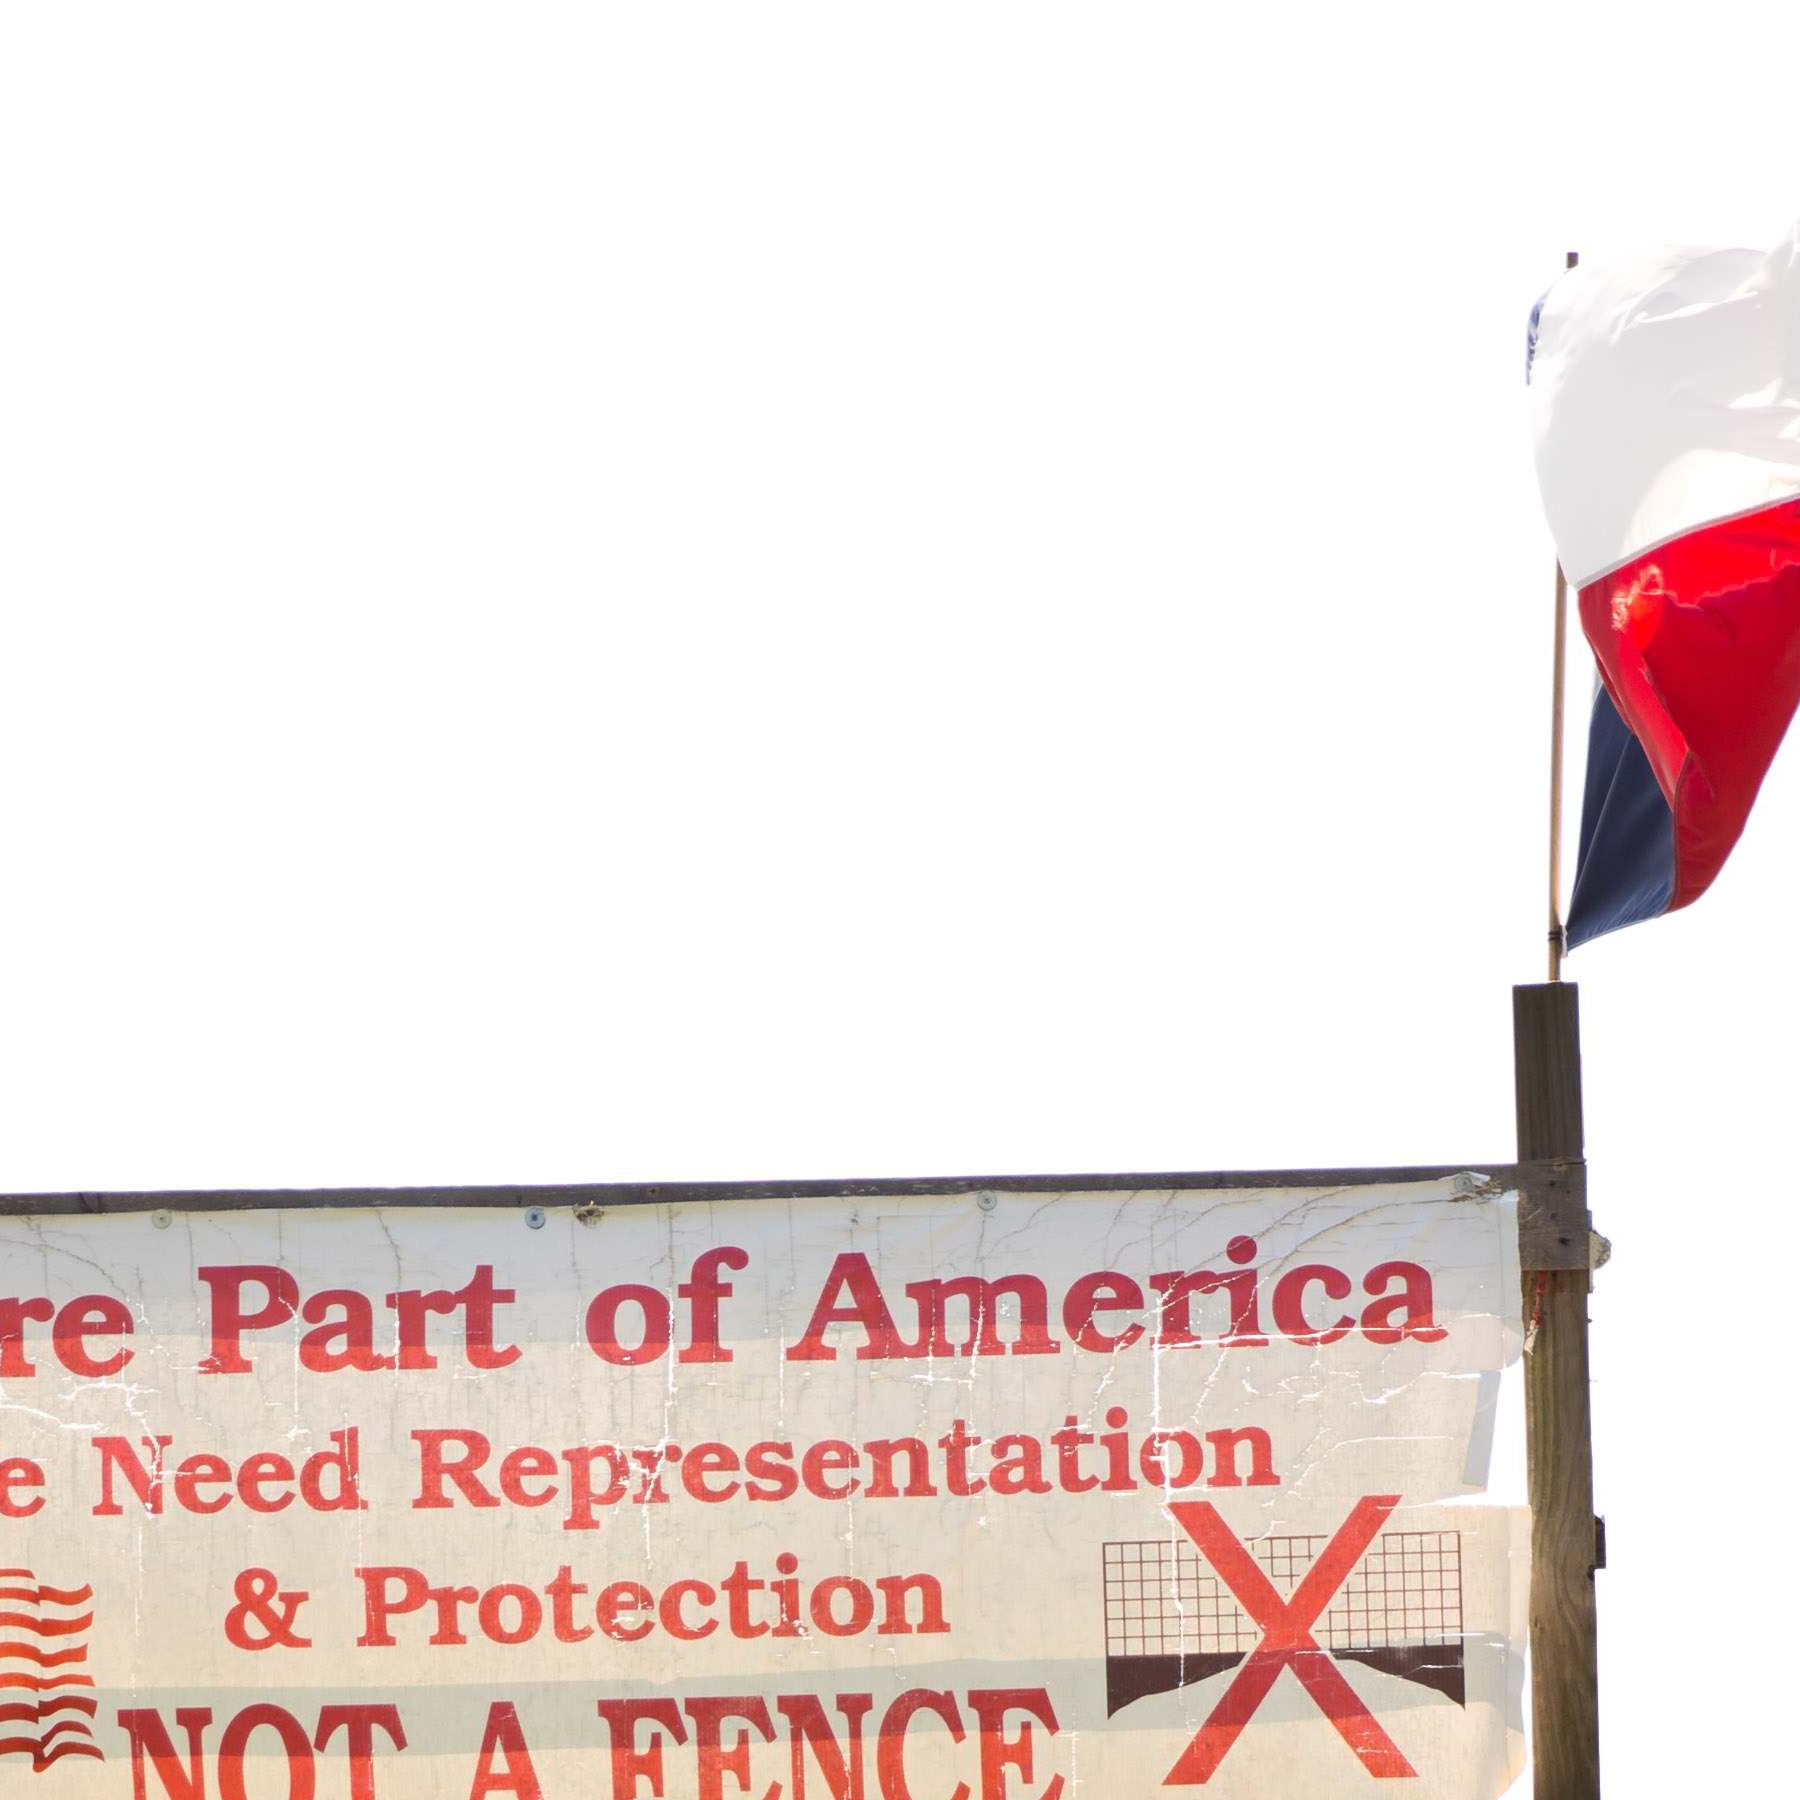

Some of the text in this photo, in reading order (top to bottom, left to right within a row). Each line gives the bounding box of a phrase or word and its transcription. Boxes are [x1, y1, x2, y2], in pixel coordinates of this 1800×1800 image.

[199, 1266, 521, 1374] Part
[586, 1247, 747, 1366] of
[787, 1236, 1448, 1361] America
[92, 1427, 368, 1515] Need
[411, 1407, 1280, 1530] Representation
[224, 1553, 950, 1651] & Protection
